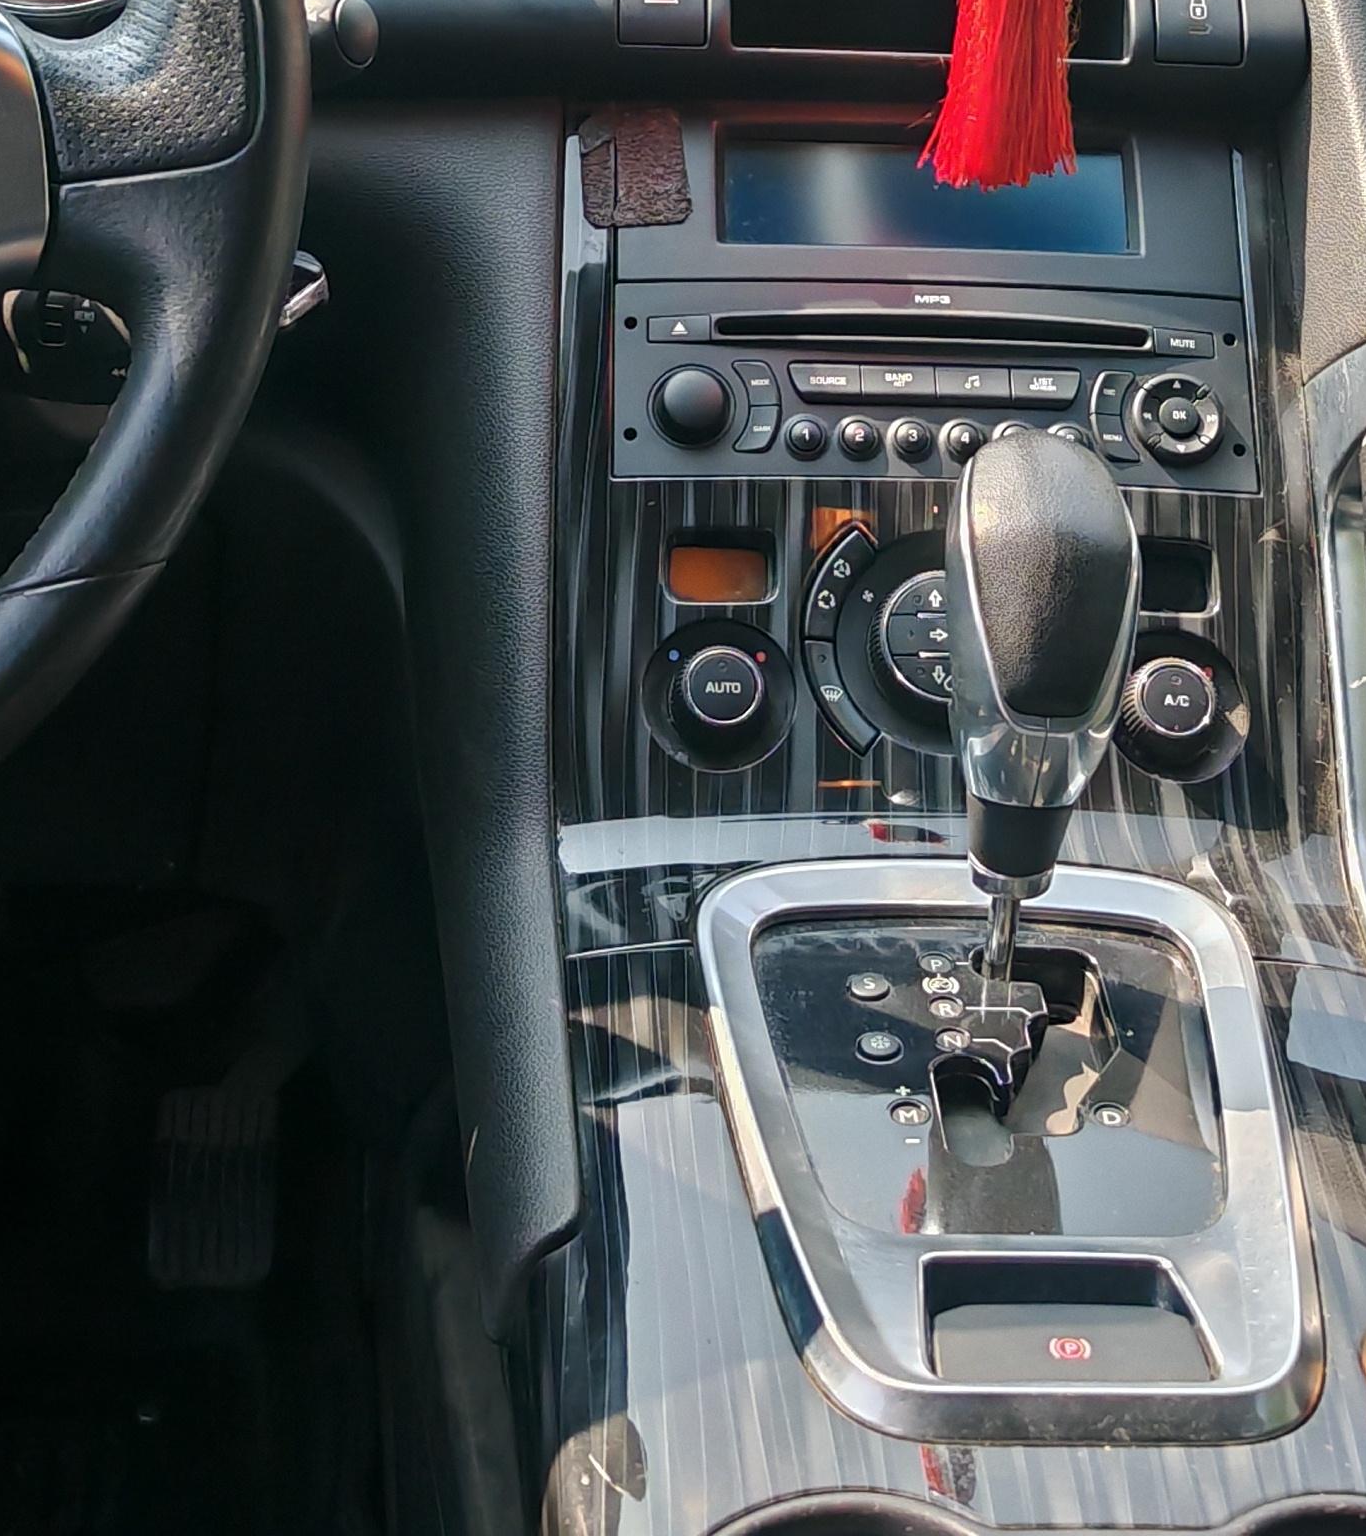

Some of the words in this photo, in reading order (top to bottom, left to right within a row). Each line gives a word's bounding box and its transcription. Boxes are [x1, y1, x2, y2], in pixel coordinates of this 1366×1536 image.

[914, 295, 951, 304] MP3
[1170, 338, 1195, 349] MUTE
[810, 376, 846, 385] SOURCE
[885, 373, 913, 381] BAND
[1033, 377, 1053, 385] LIST
[1172, 410, 1186, 420] OK
[802, 428, 810, 441] 1
[855, 428, 865, 441] 2
[908, 429, 918, 441] 3
[961, 433, 970, 444] 4
[705, 681, 741, 693] AUTO
[1164, 694, 1190, 707] A/C
[930, 959, 942, 971] P
[863, 977, 876, 989] S
[939, 1003, 955, 1017] R
[943, 1035, 962, 1048] N
[898, 1109, 919, 1122] M
[1102, 1111, 1121, 1124] D
